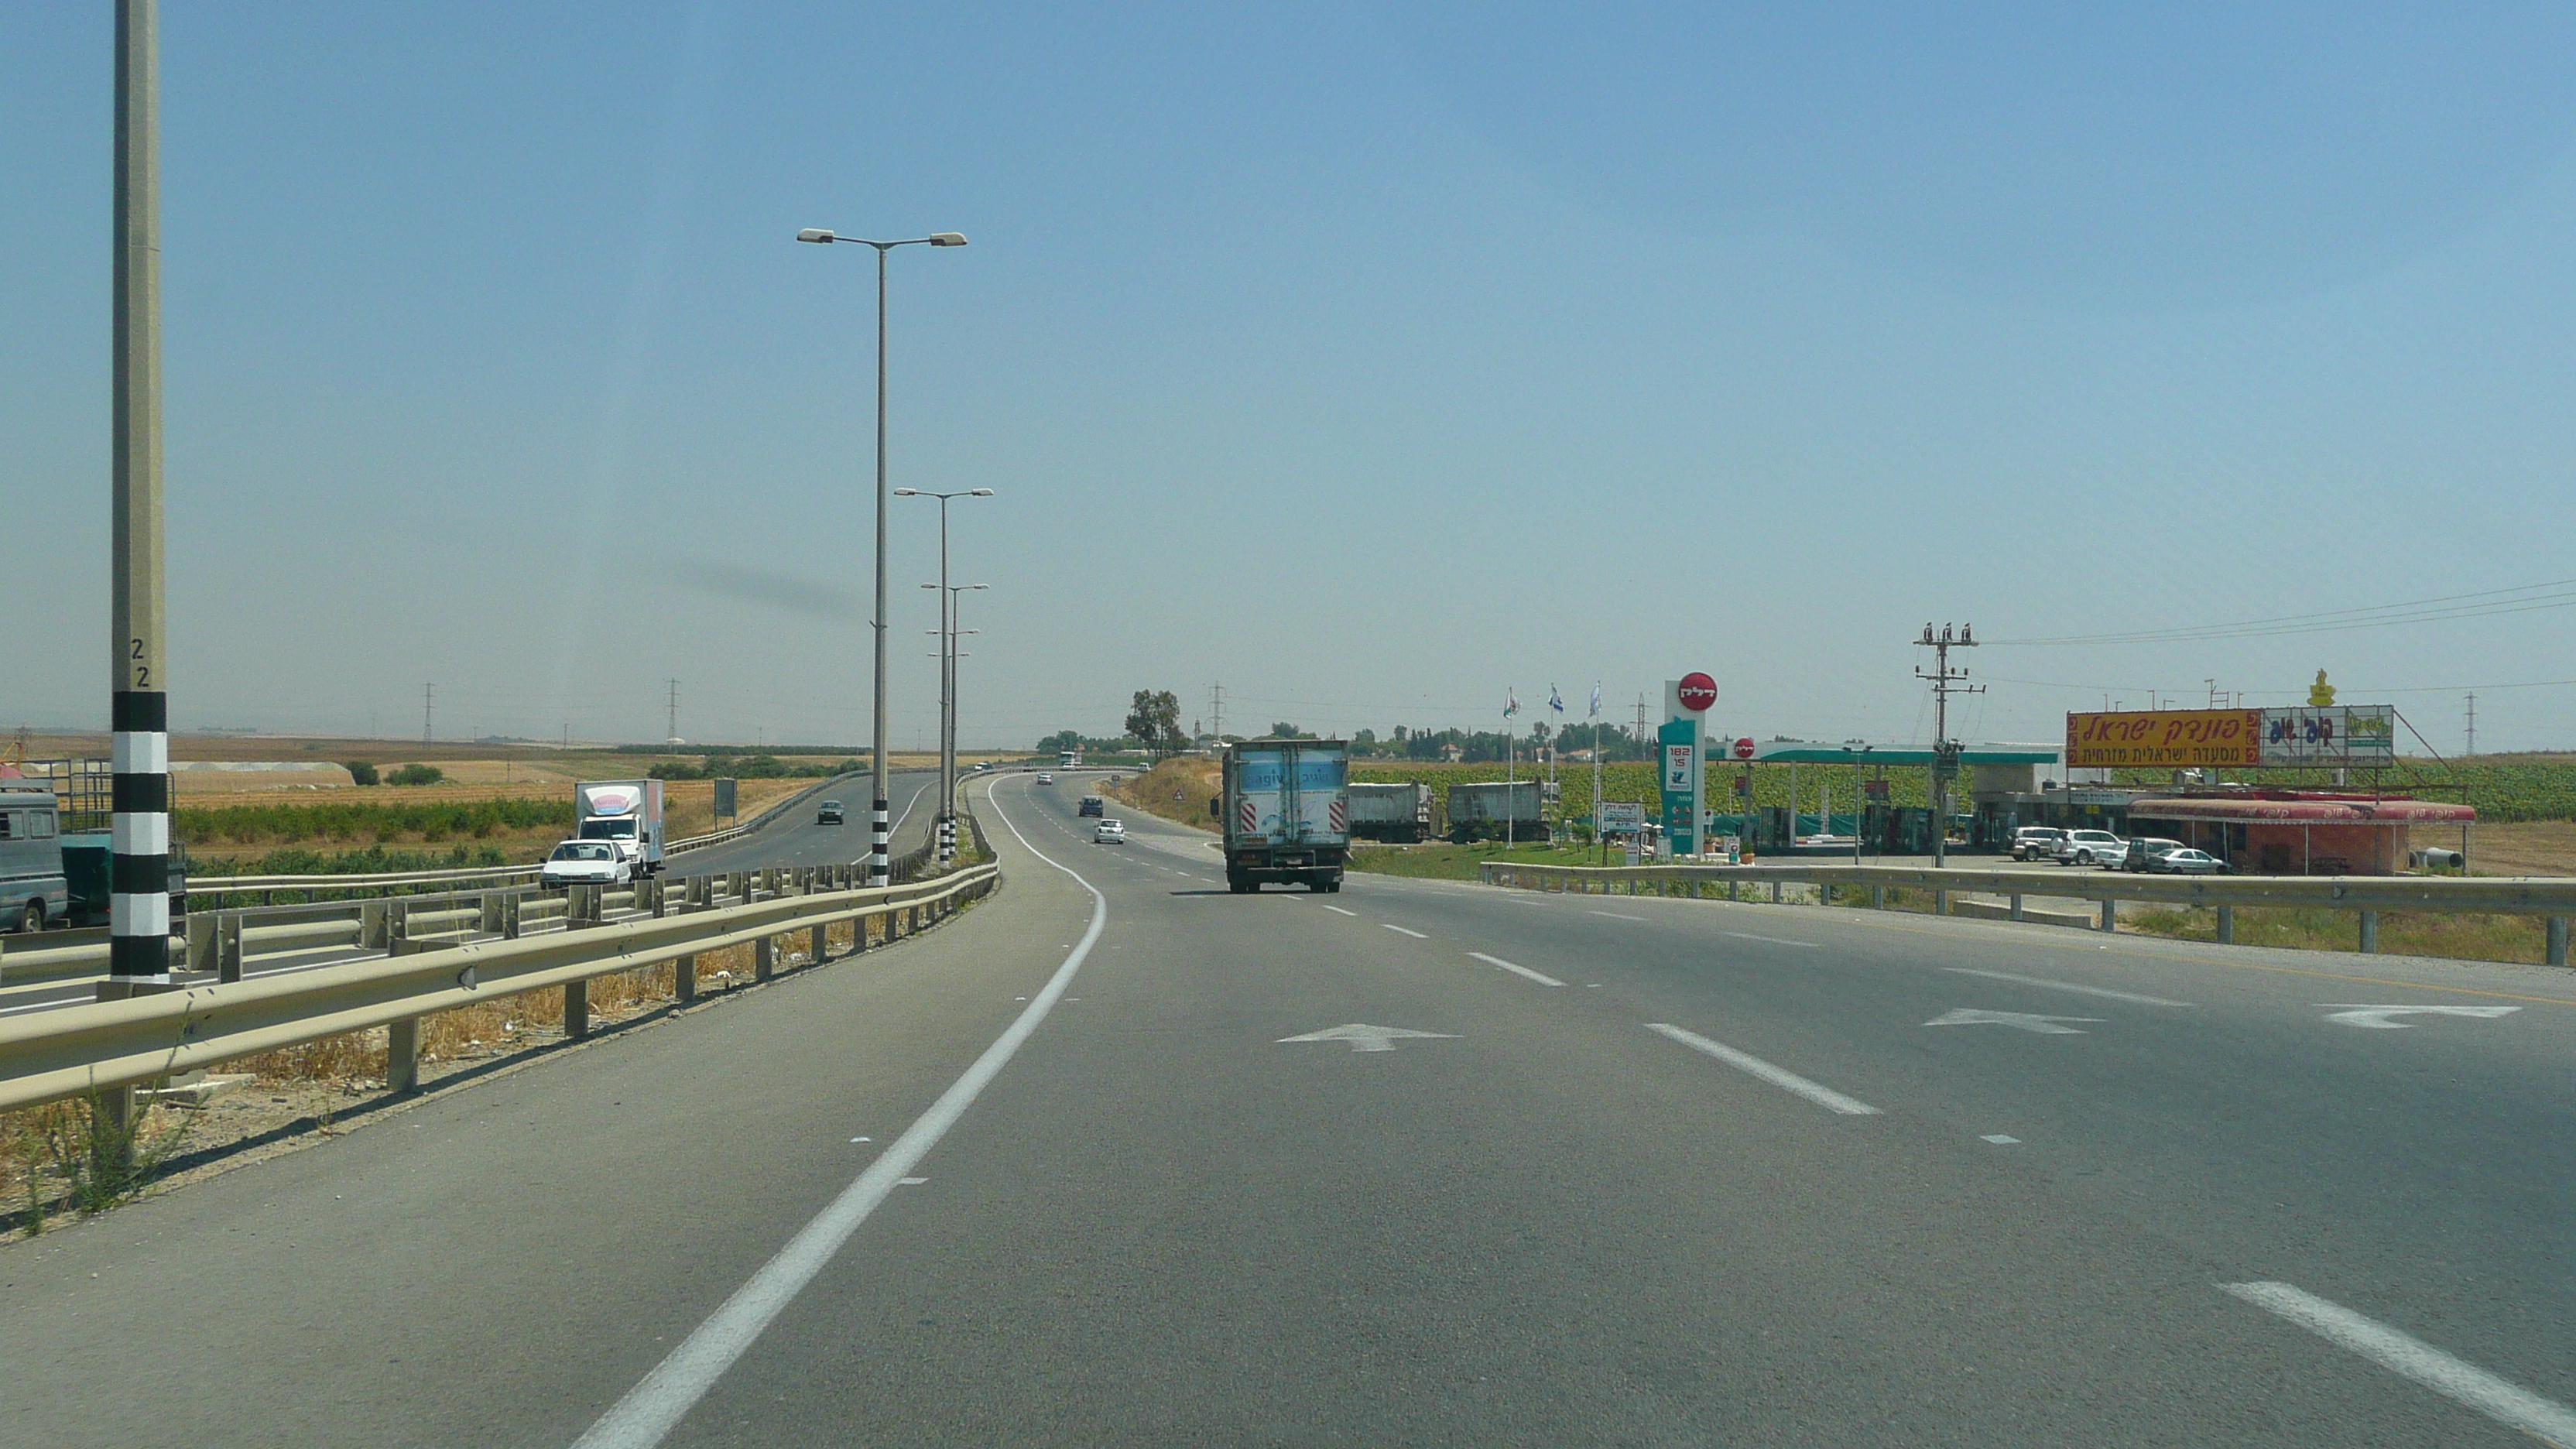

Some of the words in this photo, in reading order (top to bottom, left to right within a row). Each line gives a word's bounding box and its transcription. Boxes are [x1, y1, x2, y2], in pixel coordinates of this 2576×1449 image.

[131, 639, 144, 659] 2
[137, 666, 149, 687] 2
[1680, 686, 1716, 698] דלק
[2082, 716, 2156, 742] ישראל
[2163, 718, 2241, 745] פונדק
[1670, 748, 1690, 756] 182
[2082, 747, 2127, 762] מזרחית
[2132, 745, 2187, 762] ישראלית
[2192, 747, 2240, 762] מסעדה
[1247, 769, 1284, 786] sagiv
